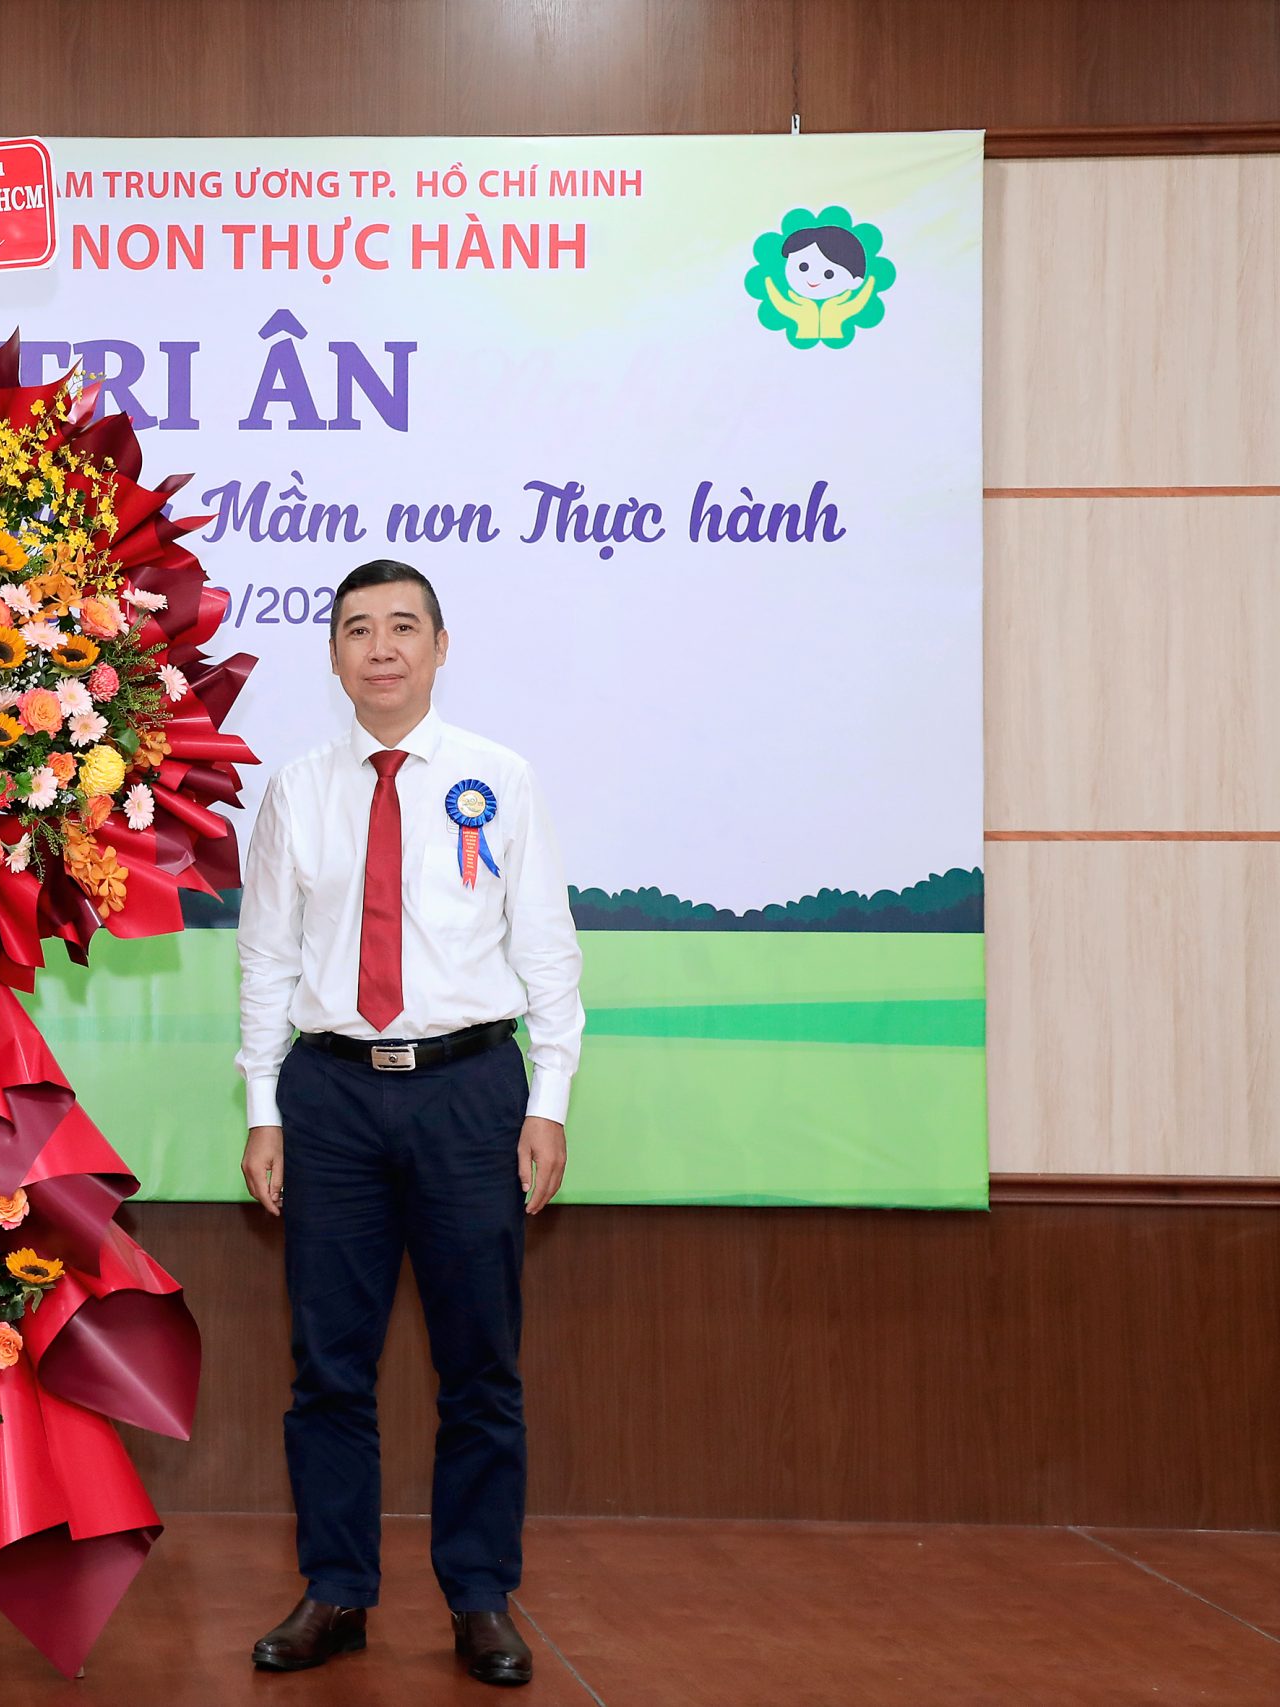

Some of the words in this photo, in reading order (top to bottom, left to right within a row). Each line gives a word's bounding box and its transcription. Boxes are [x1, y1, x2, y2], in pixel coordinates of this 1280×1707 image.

[102, 171, 222, 198] TRUNG
[235, 166, 340, 198] ƯƠNG
[349, 171, 396, 198] TP.
[417, 162, 467, 198] HỒ
[479, 164, 539, 197] CHÍ
[550, 170, 642, 197] MINH
[72, 224, 204, 270] NON
[222, 216, 390, 284] THỰC
[411, 213, 586, 270] HÀNH
[238, 308, 418, 432] ÂN
[201, 470, 367, 543] Mầm
[386, 504, 500, 543] non
[520, 480, 666, 560] Thực
[689, 480, 847, 543] hành
